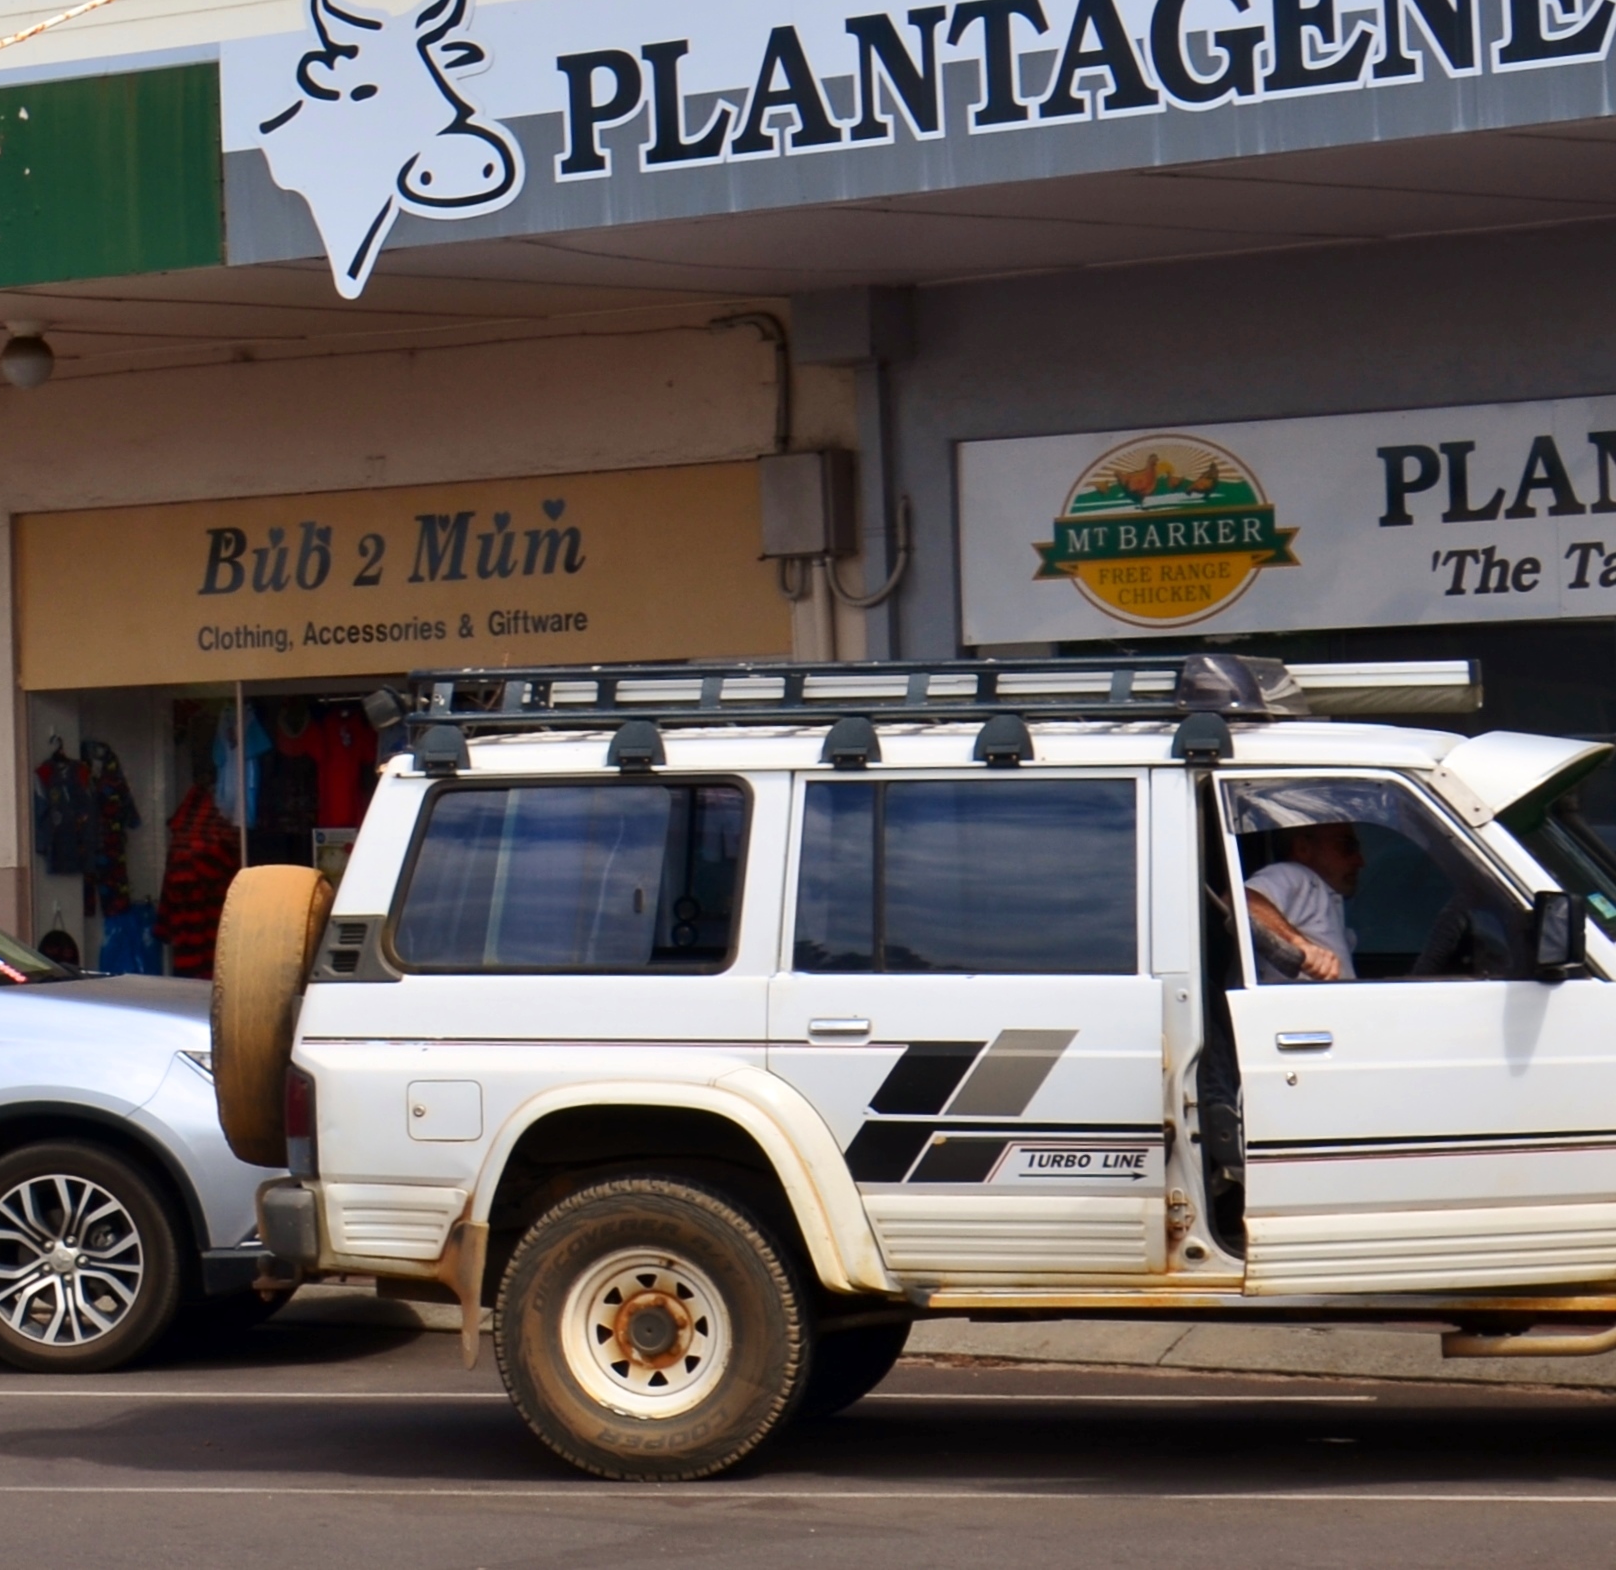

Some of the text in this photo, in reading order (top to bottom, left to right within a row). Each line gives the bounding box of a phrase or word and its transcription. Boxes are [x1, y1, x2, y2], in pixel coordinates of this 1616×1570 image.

[1119, 518, 1264, 550] BARKER
[197, 507, 587, 596] Bub 2 Mum
[1099, 562, 1231, 585] FREE RANGE
[1118, 585, 1212, 605] CHICKEN
[198, 609, 588, 653] Clothing, Accessories & Giftware
[1102, 1154, 1147, 1168] LINE
